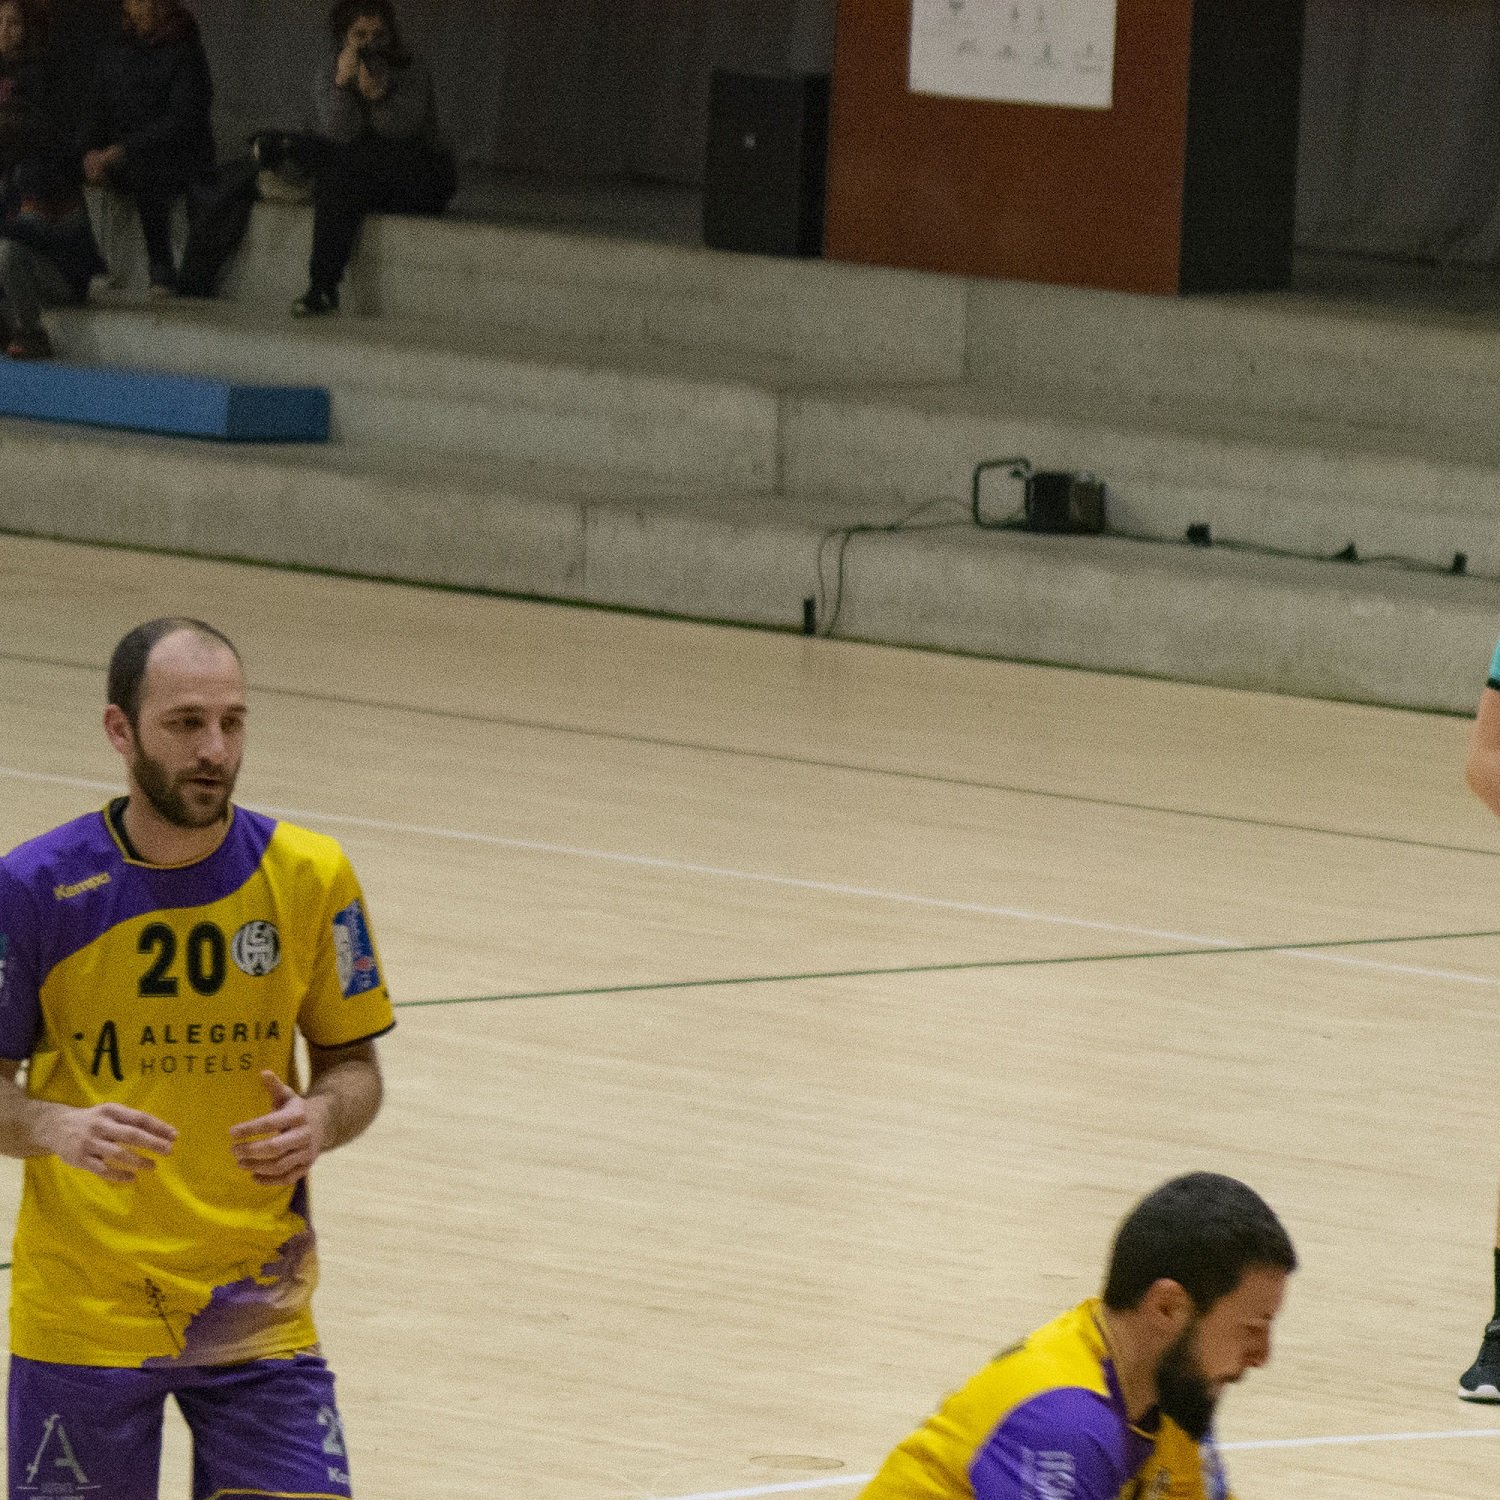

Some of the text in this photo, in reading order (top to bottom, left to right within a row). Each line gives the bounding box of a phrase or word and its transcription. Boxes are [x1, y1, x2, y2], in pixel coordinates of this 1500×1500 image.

[137, 921, 227, 999] 20
[138, 1020, 281, 1046] ALEGRIA
[138, 1053, 254, 1076] HOTELS
